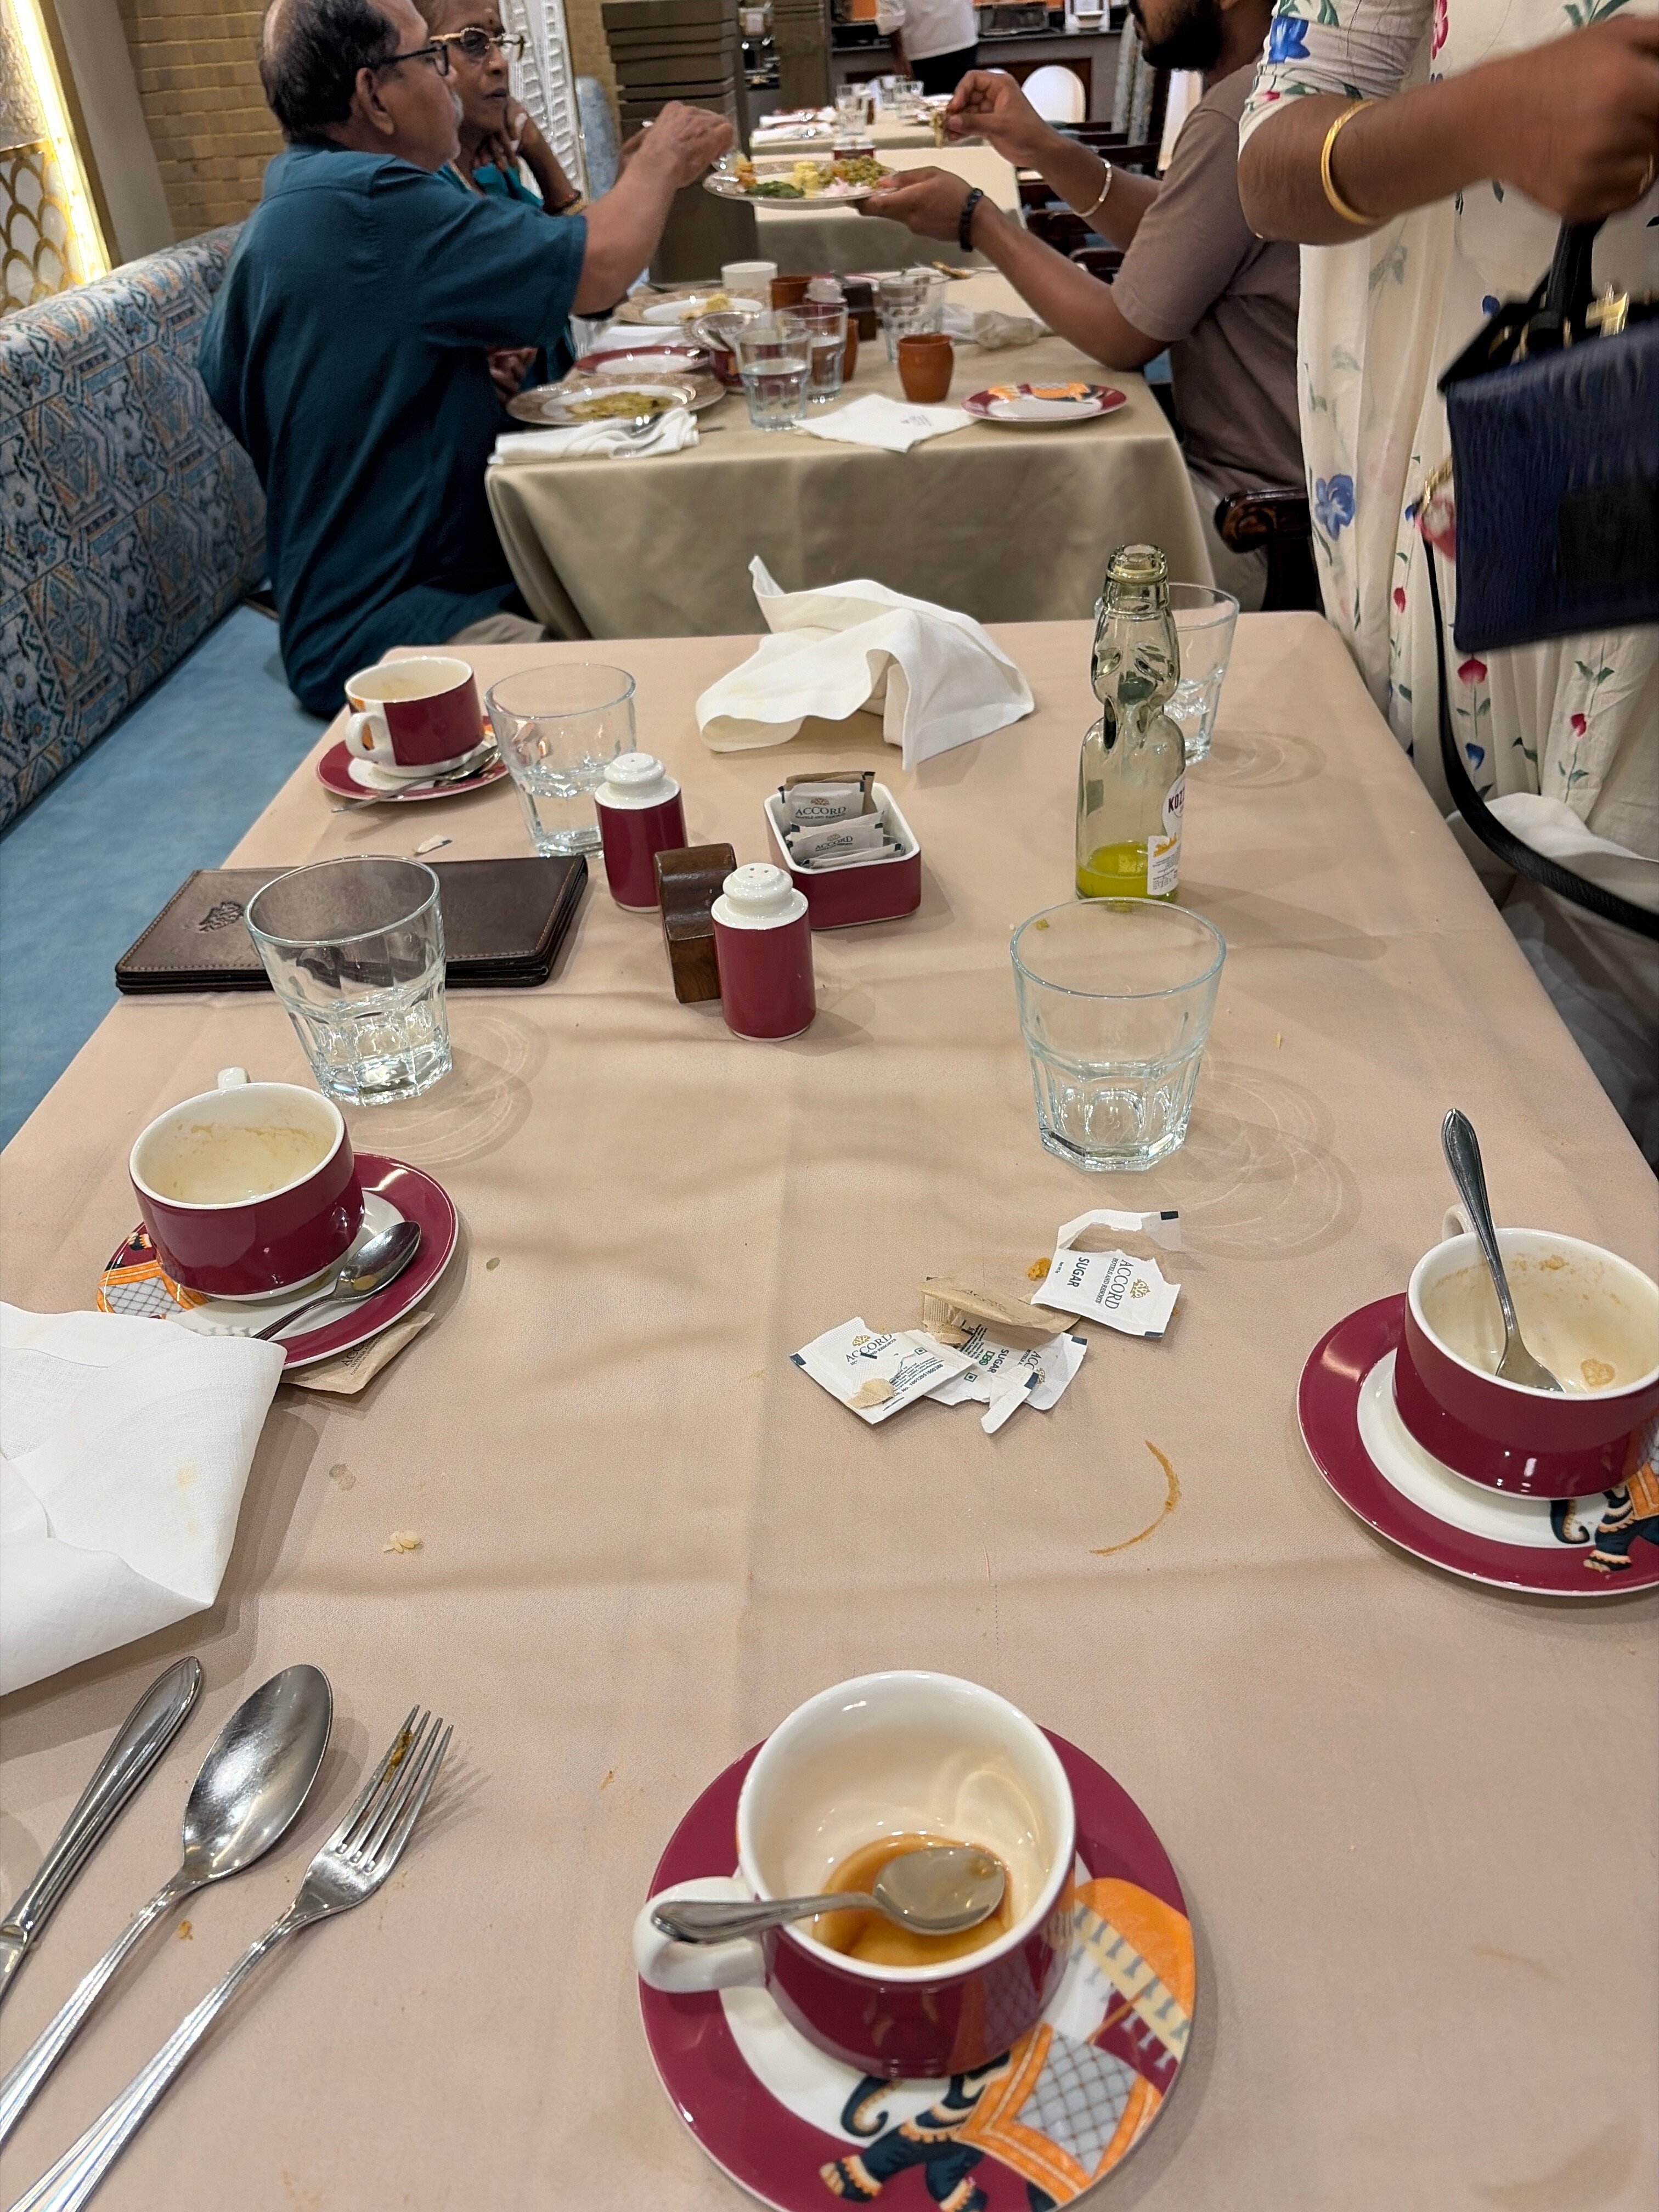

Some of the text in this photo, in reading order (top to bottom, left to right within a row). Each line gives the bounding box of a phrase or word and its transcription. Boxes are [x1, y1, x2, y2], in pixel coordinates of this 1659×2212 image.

[795, 806, 847, 816] ACCORD
[815, 836, 853, 850] ACCORD
[1067, 1257, 1090, 1288] SUGAR
[1108, 1257, 1119, 1274] HOTELS
[1095, 1284, 1107, 1304] RESORTS
[1104, 1259, 1134, 1310] ACCORD
[341, 1344, 364, 1366] ACC
[988, 1348, 1009, 1373] SUGAR
[1025, 1351, 1042, 1369] ACC
